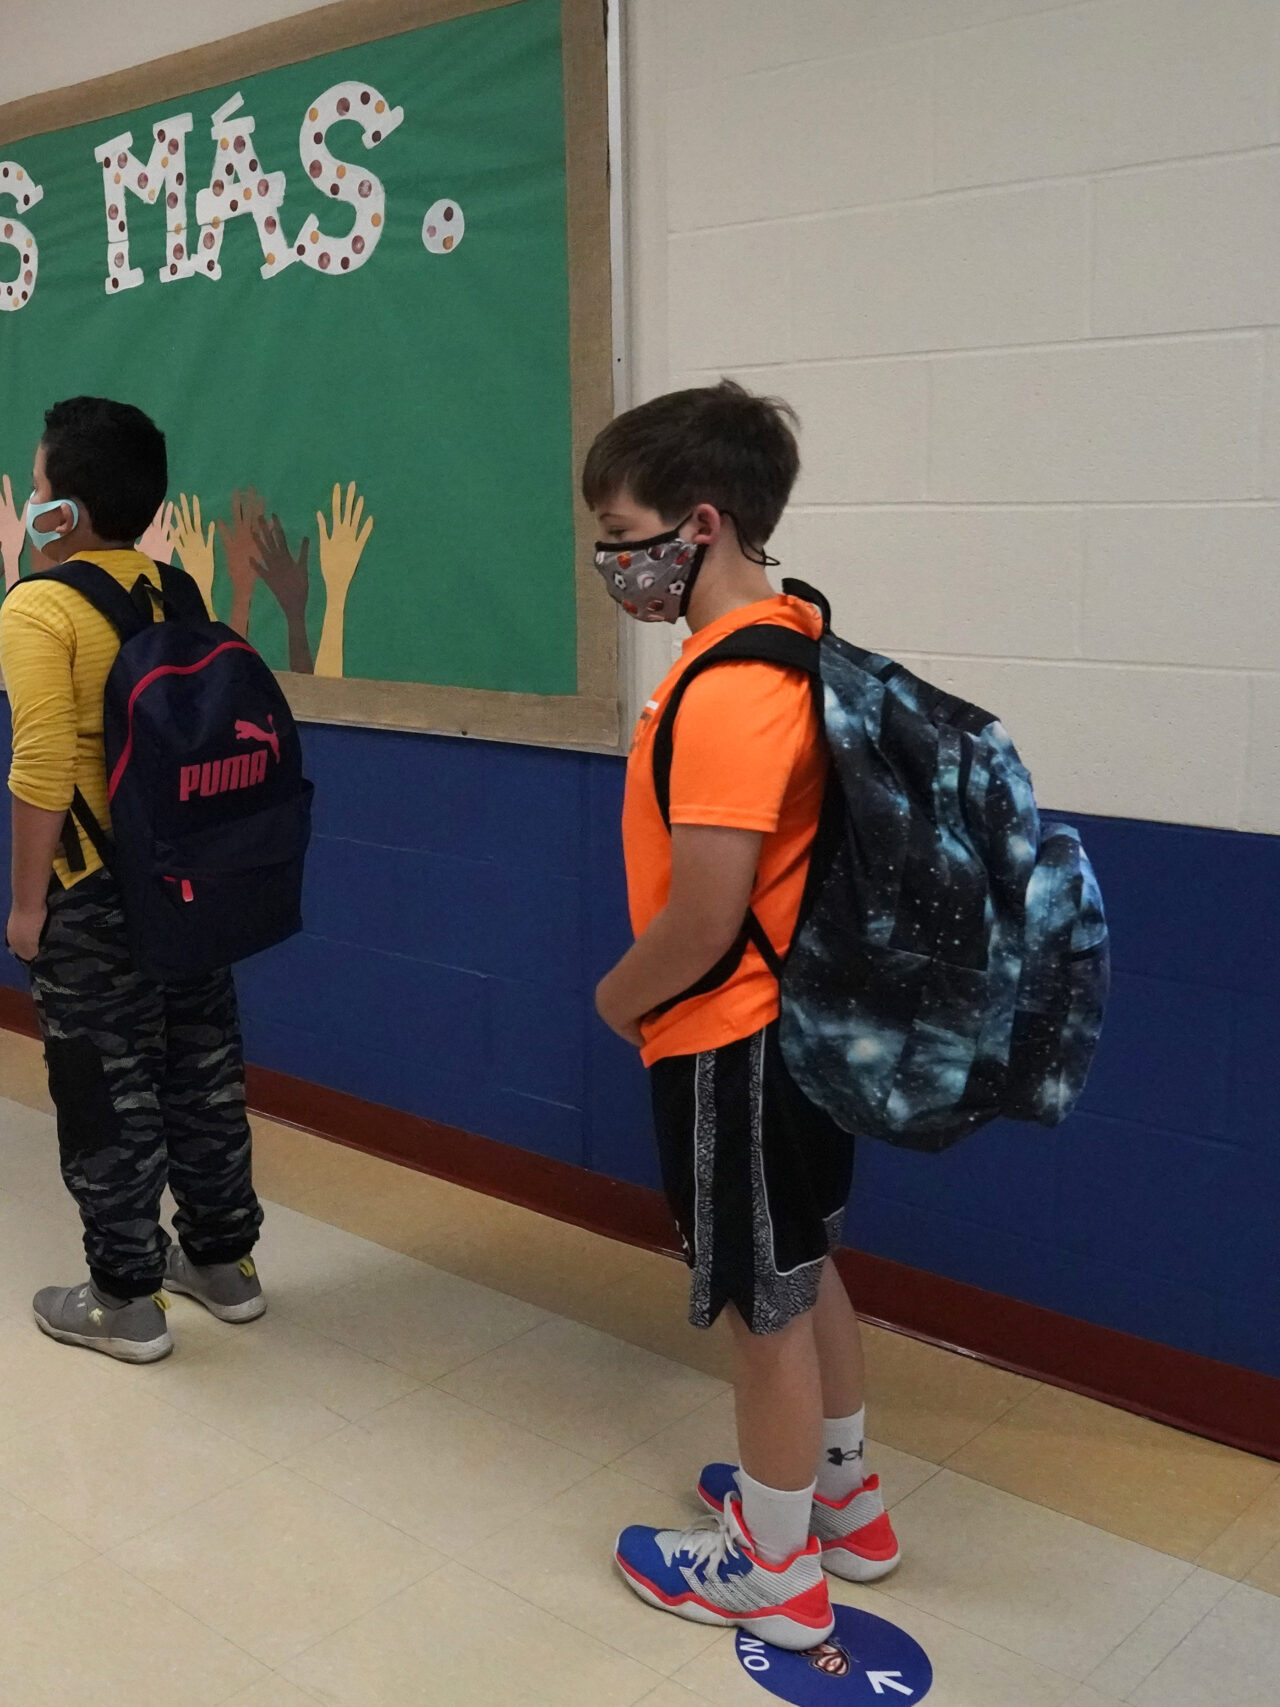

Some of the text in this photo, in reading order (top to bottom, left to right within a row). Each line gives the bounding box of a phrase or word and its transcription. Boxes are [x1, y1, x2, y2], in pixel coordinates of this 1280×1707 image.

[94, 81, 465, 295] MÁS.
[179, 749, 268, 801] PUMA
[739, 1637, 770, 1671] ON
